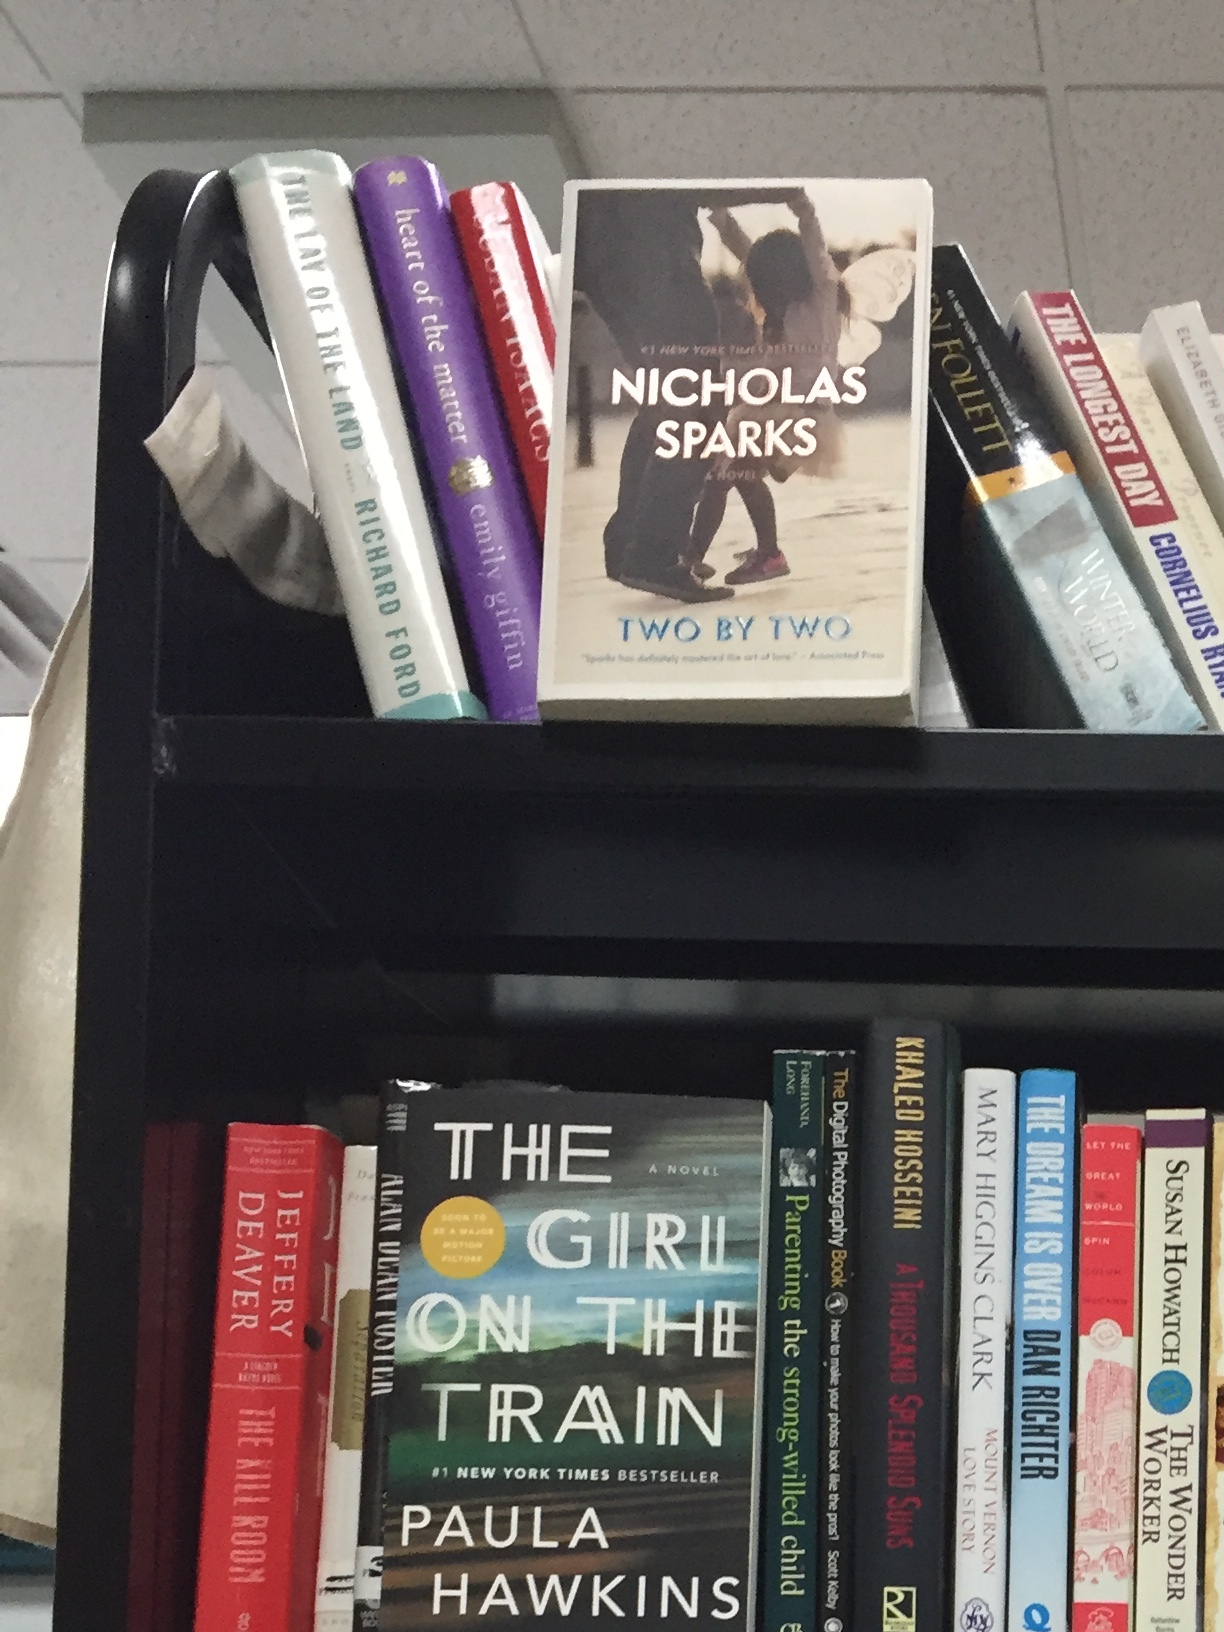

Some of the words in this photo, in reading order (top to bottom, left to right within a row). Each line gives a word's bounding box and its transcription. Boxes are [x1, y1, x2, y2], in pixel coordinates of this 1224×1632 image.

[395, 208, 426, 271] heart
[412, 279, 444, 308] of
[1041, 302, 1088, 347] THE
[421, 312, 450, 353] the
[610, 365, 868, 407] NICHOLAS
[931, 337, 1014, 453] FOLLETT
[1175, 325, 1222, 411] ELIZABETH
[432, 362, 468, 445] matter
[1063, 351, 1140, 458] LONGEST
[654, 417, 818, 460] SPARKS
[1113, 460, 1165, 509] DAY
[354, 497, 402, 616] RICHARD
[385, 626, 422, 699] FORD
[1080, 547, 1137, 645] WINTER
[1148, 530, 1221, 642] CORNELIUS
[617, 615, 702, 643] TWO
[715, 614, 756, 642] BY
[768, 614, 852, 642] TWO
[785, 1060, 798, 1095] LONG
[831, 1068, 850, 1099] The
[893, 1036, 925, 1122] KHALED
[828, 1100, 850, 1149] Digital
[975, 1086, 999, 1164] MARY
[1025, 1094, 1067, 1135] THE
[1085, 1140, 1108, 1151] LET
[1109, 1141, 1132, 1151] THE
[433, 1121, 613, 1184] THE
[648, 1163, 659, 1175] A
[666, 1163, 721, 1177] NOVEL
[892, 1129, 924, 1230] HOSSEINI
[1023, 1140, 1066, 1226] DREAM
[1084, 1171, 1122, 1182] GREAT
[827, 1151, 850, 1248] Photography
[973, 1171, 997, 1286] HIGGINS
[1083, 1202, 1124, 1213] WORLD
[1163, 1159, 1191, 1238] SUSAN
[228, 1189, 266, 1332] DEAVER
[268, 1188, 304, 1338] JEFFERY
[440, 1254, 483, 1263] PICTURE
[442, 1241, 484, 1250] MOTION
[526, 1208, 738, 1272] GIRL
[777, 1192, 811, 1312] Parenting
[829, 1249, 848, 1289] Book
[1023, 1231, 1064, 1256] IS
[1083, 1236, 1111, 1247] SPIN
[1022, 1261, 1064, 1322] OVER
[1161, 1241, 1189, 1367] HOWATCH
[405, 1291, 532, 1354] ON
[575, 1296, 755, 1359] THE
[783, 1317, 808, 1359] the
[970, 1293, 995, 1392] CLARK
[1021, 1328, 1062, 1378] DAN
[420, 1382, 725, 1448] TRAIN
[775, 1366, 807, 1527] strong-willed
[1019, 1384, 1061, 1481] RICHTER
[431, 1467, 449, 1479] #1
[457, 1467, 498, 1479] NEW
[502, 1467, 551, 1480] YORK
[556, 1468, 610, 1481] TIMES
[617, 1469, 721, 1484] BESTSELLER
[1168, 1423, 1196, 1479] THE
[1140, 1423, 1170, 1547] WORKER
[400, 1504, 611, 1550] PAULA
[1165, 1481, 1194, 1602] WONDER
[431, 1572, 742, 1621] HAWKINS
[779, 1534, 807, 1597] child
